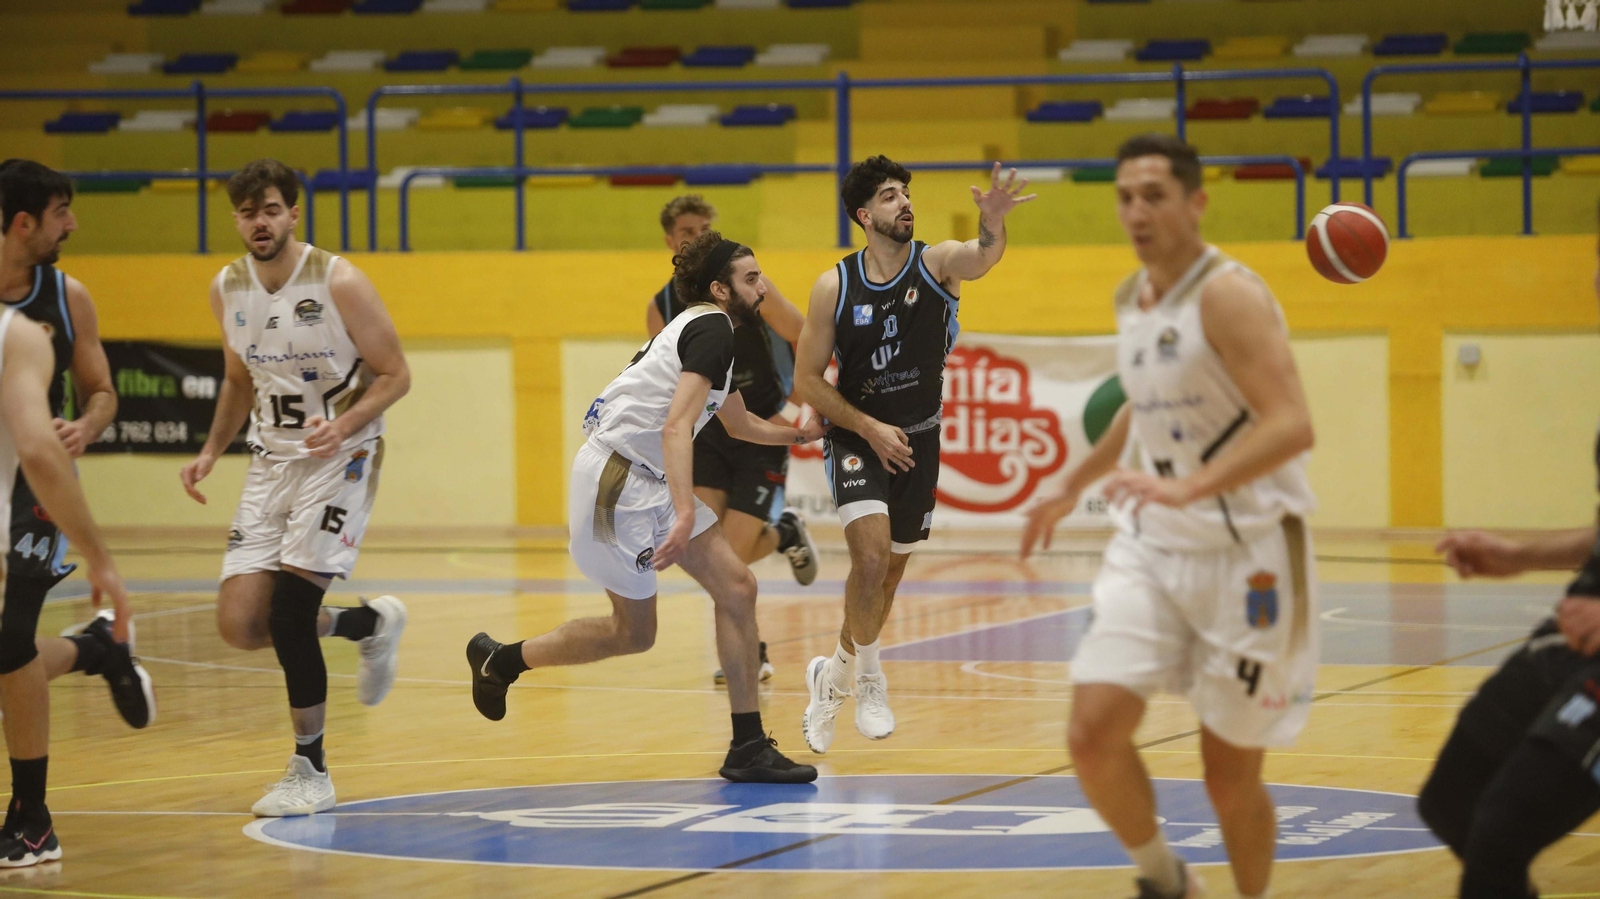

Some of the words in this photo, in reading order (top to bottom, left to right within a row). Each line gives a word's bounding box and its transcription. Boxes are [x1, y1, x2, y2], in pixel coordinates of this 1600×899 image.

[117, 369, 176, 397] fibra
[182, 376, 216, 398] en
[270, 395, 305, 429] 15
[756, 485, 769, 505] 7
[843, 478, 866, 488] vive
[320, 505, 347, 535] 15
[14, 532, 50, 561] 44
[1236, 657, 1262, 697] 4
